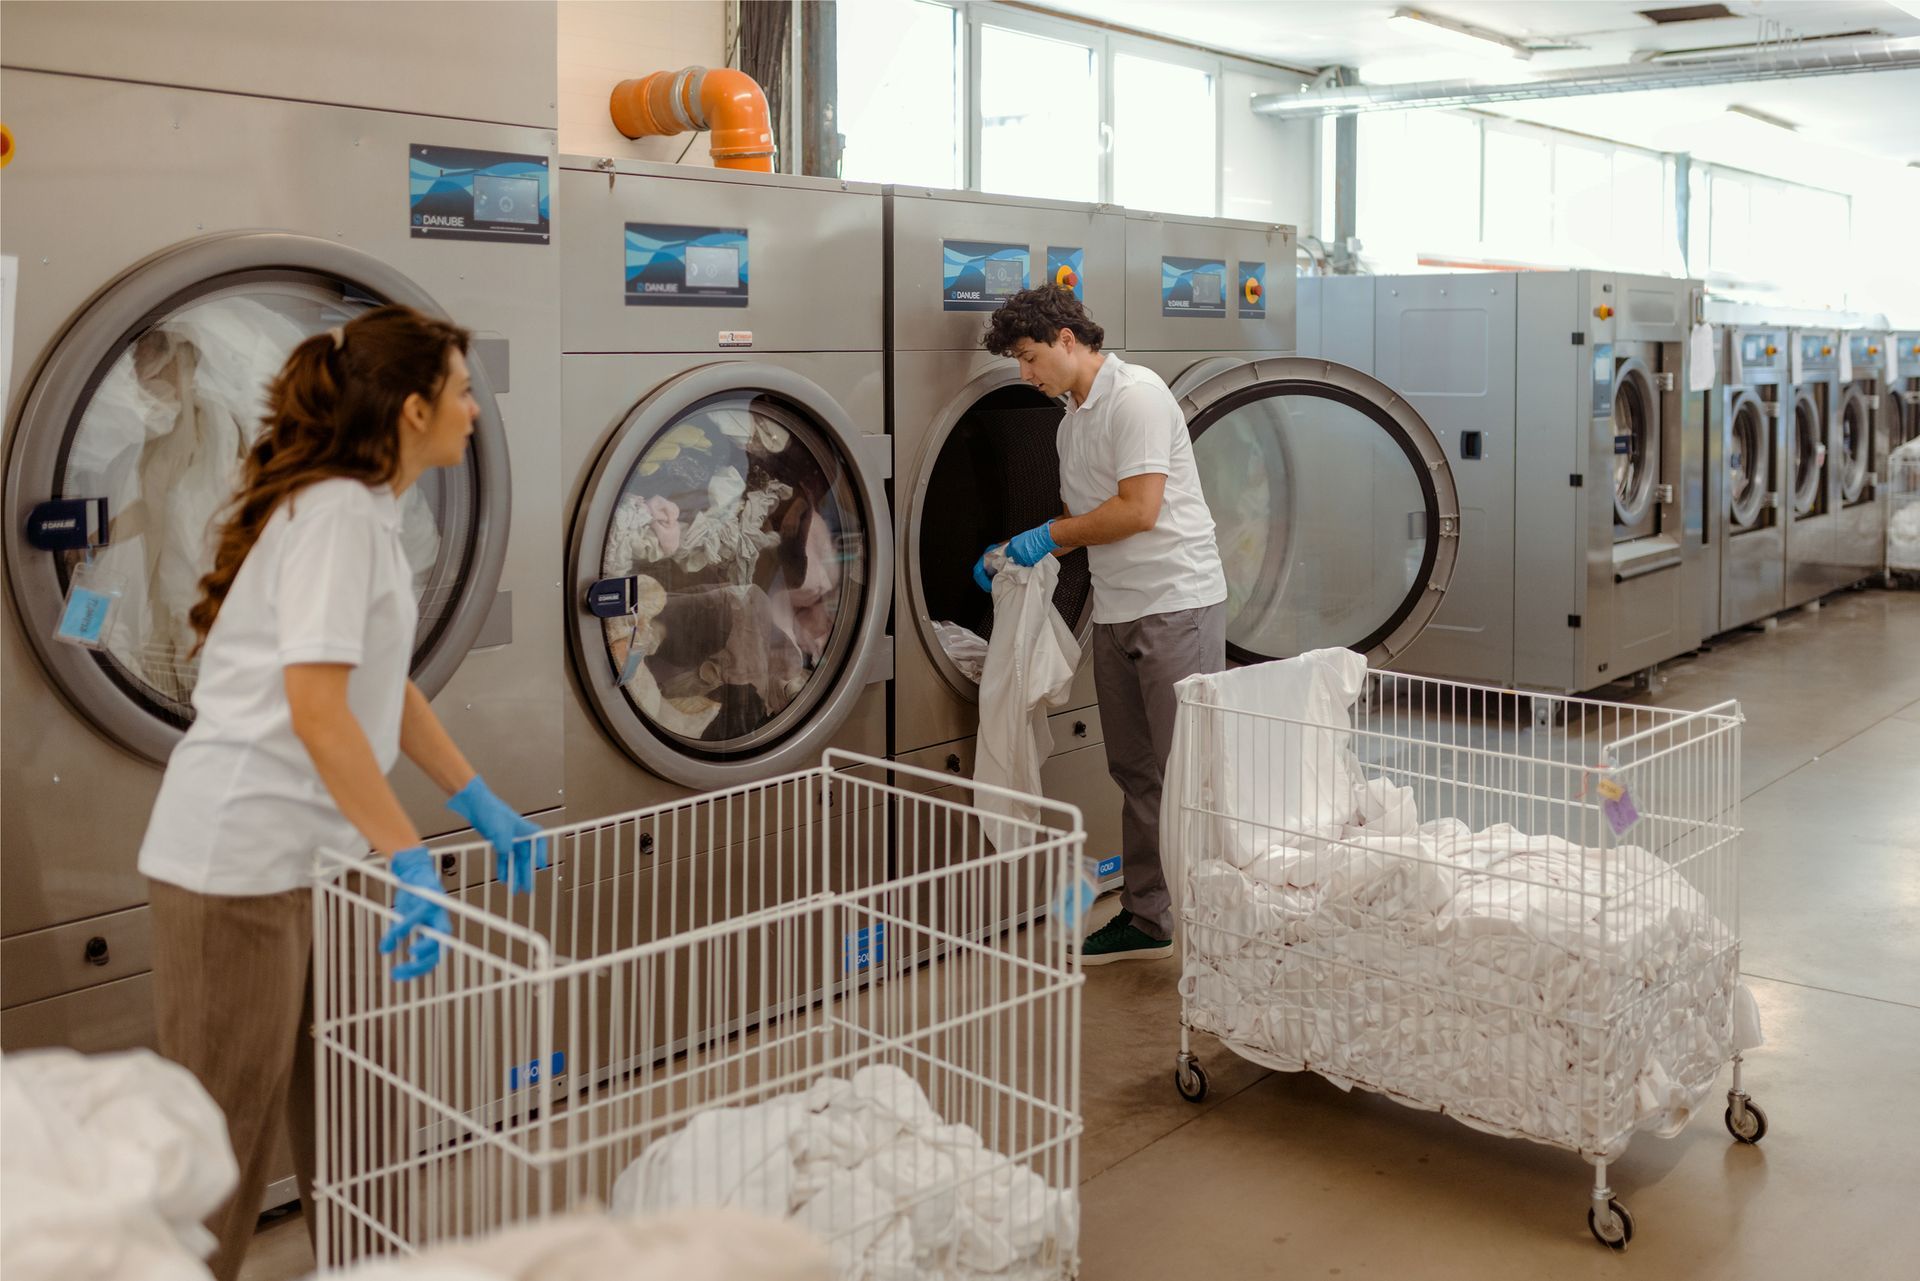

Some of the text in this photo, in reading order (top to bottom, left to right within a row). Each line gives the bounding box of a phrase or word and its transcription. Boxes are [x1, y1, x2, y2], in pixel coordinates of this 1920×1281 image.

[423, 215, 465, 227] DANUBE
[645, 282, 679, 293] DANUBE
[956, 291, 980, 300] DANUBE
[1100, 862, 1114, 873] GOLD
